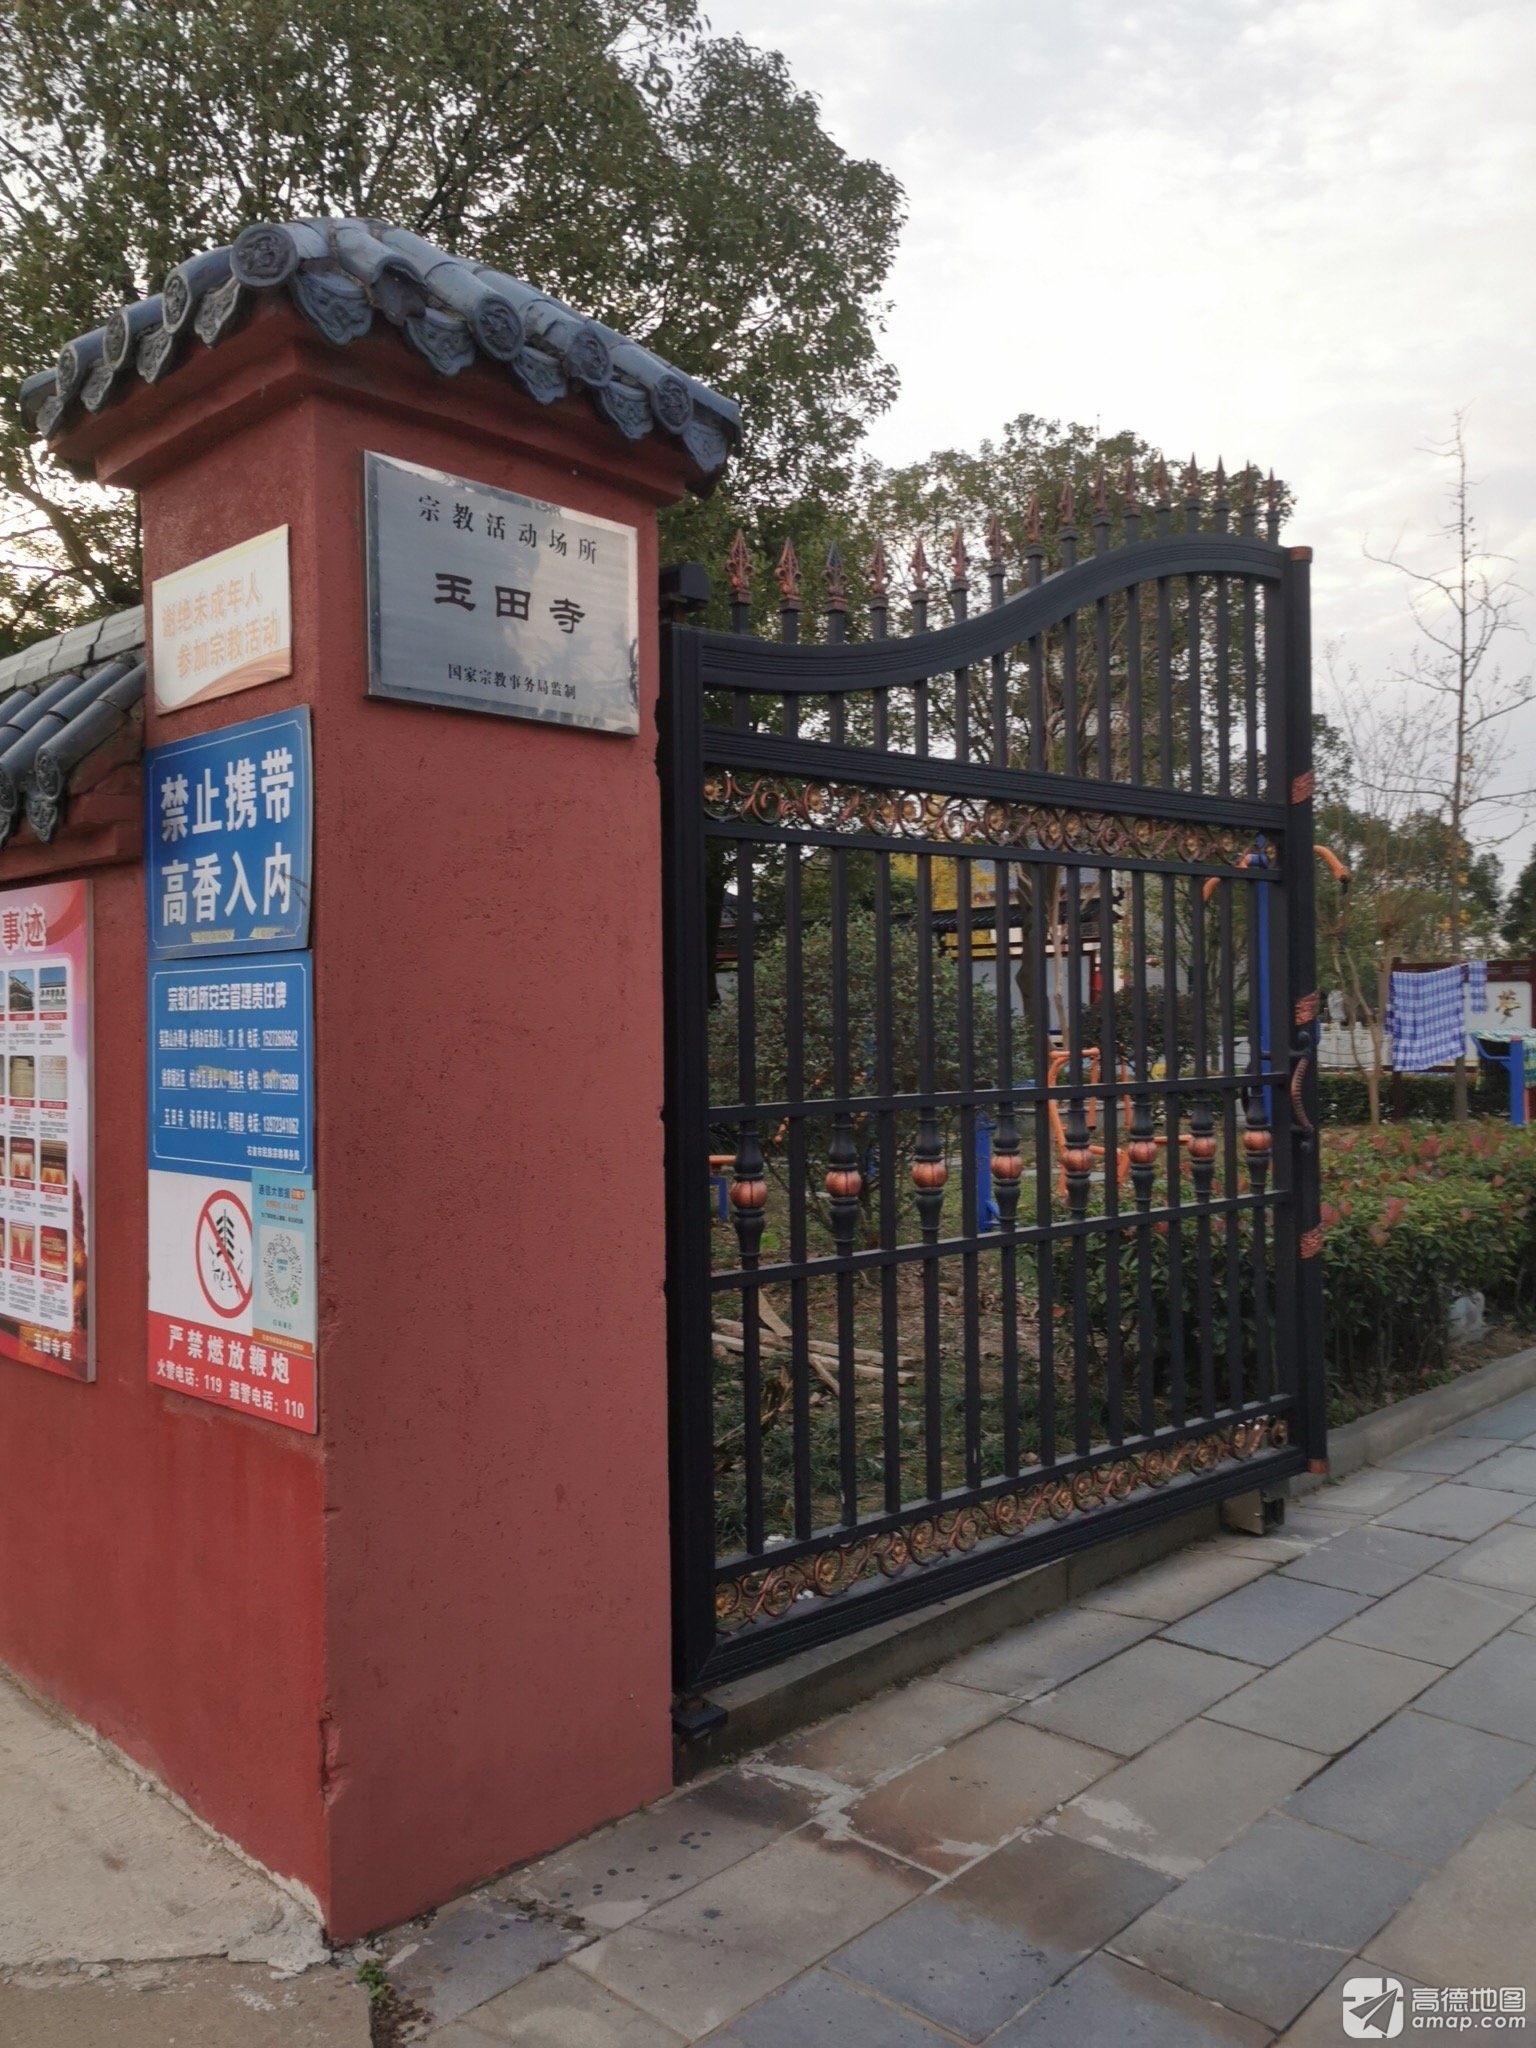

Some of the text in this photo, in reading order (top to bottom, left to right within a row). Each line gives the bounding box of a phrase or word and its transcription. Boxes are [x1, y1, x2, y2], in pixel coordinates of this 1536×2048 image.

[418, 496, 597, 565] 宗教活动场所
[434, 572, 586, 634] 玉田寺
[176, 608, 280, 678] 参加宗教活动
[448, 663, 577, 699] 国家宗教事务局监制
[160, 747, 294, 842] 禁止携带
[161, 842, 292, 926] 高香入内
[2, 908, 44, 950] 事迹
[167, 981, 287, 1012] 宗教场所安全管理责任牌
[168, 1324, 290, 1385] 严禁燃放鞭炮
[204, 1373, 222, 1394] 119
[284, 1397, 305, 1420] 110
